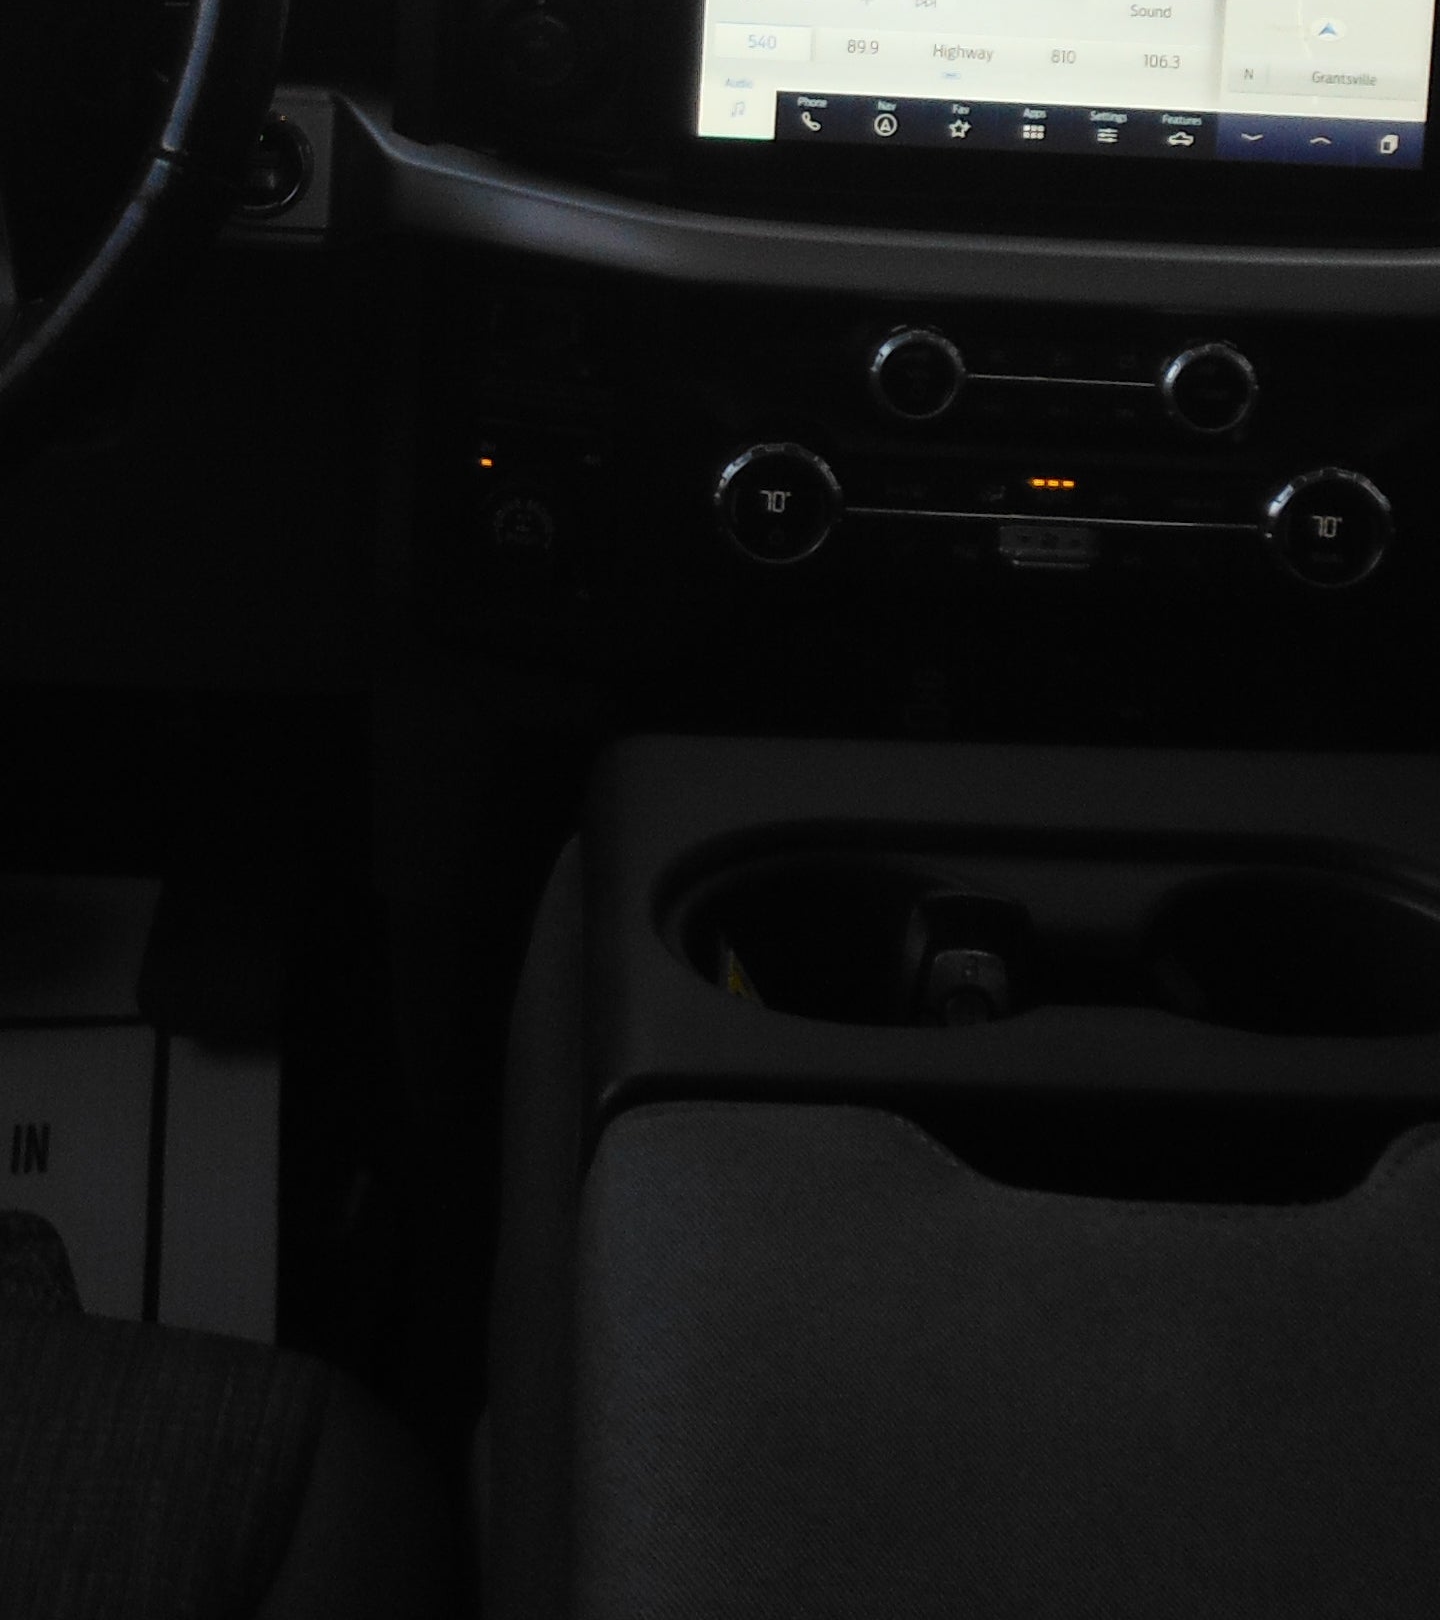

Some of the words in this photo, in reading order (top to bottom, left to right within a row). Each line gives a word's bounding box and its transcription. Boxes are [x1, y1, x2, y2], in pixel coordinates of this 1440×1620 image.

[1129, 3, 1173, 20] Sound
[747, 34, 778, 51] 540
[847, 38, 880, 55] 89.9
[932, 43, 994, 63] Highway
[1050, 48, 1077, 65] 810
[1142, 53, 1182, 70] 106.3
[1243, 68, 1254, 81] N
[1311, 70, 1378, 88] Grantsville
[796, 95, 828, 108] Phone
[1022, 106, 1047, 120] Apps
[1089, 110, 1128, 125] Settings
[1161, 112, 1204, 127] Features
[9, 1122, 53, 1175] IN
